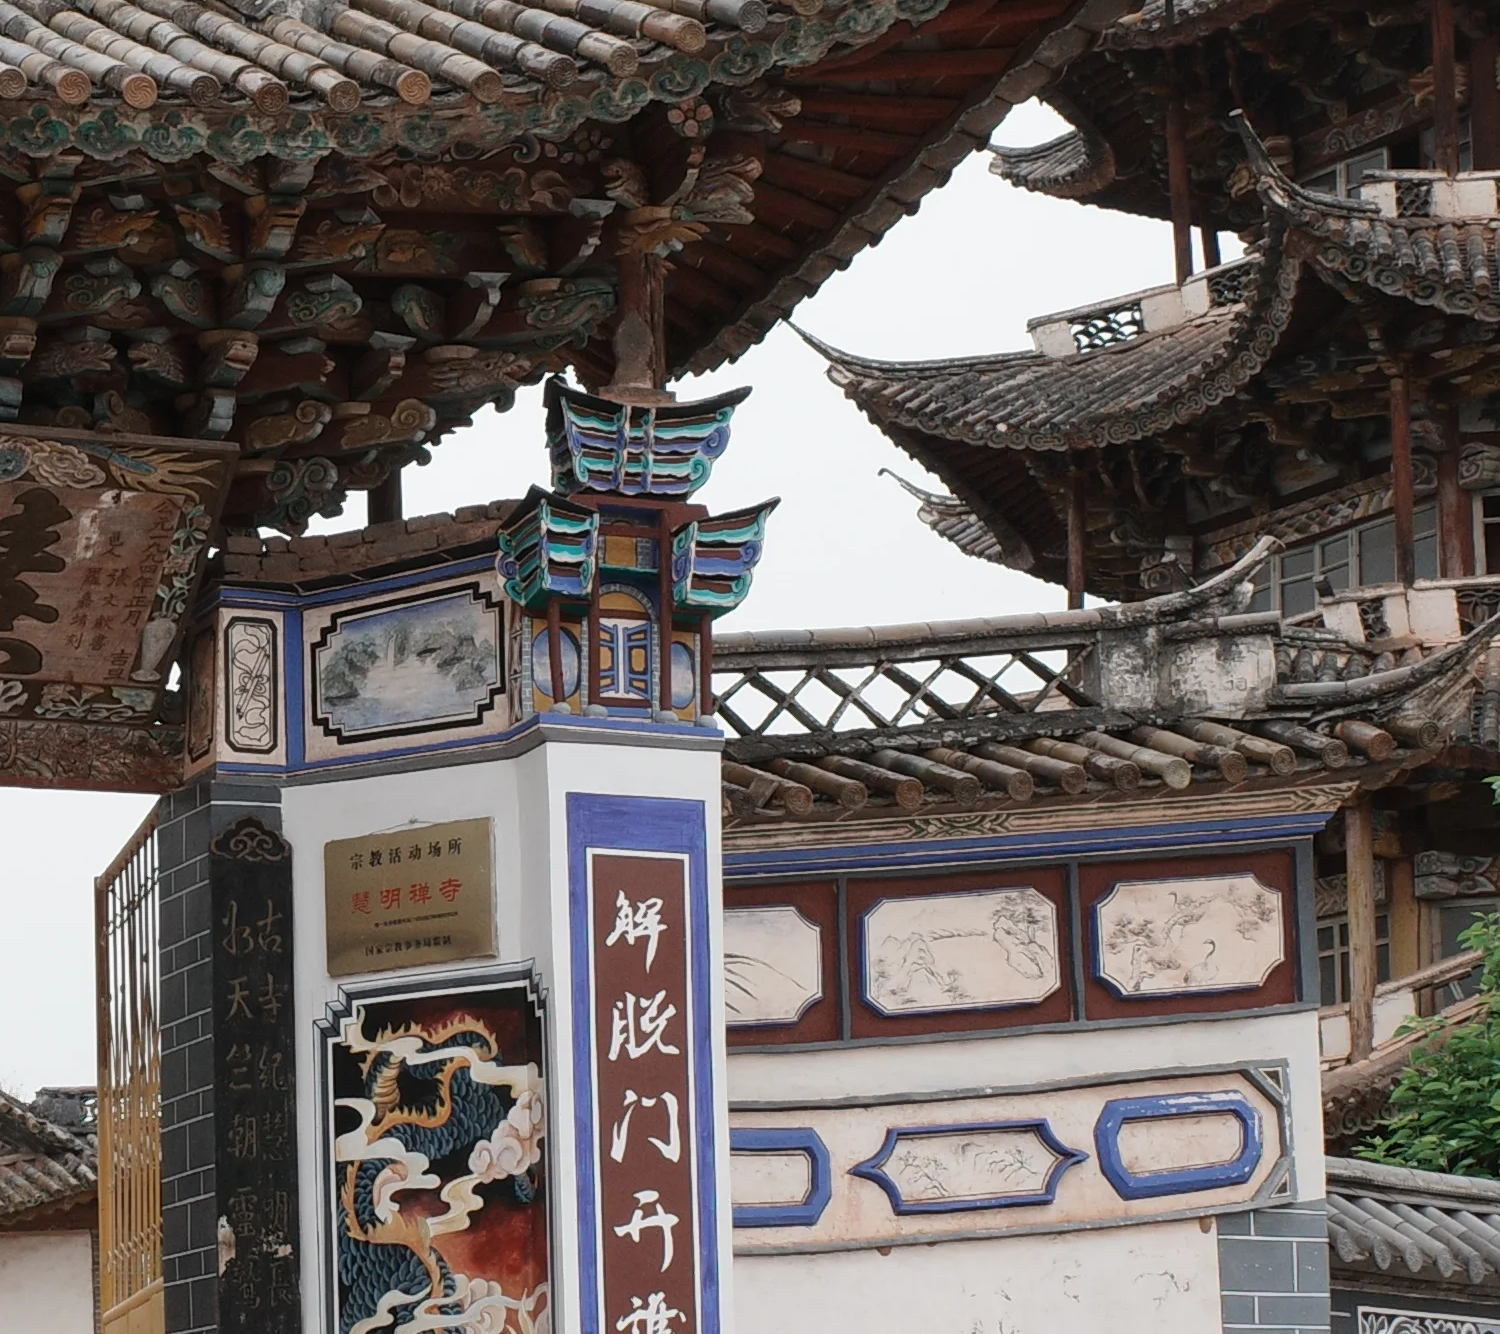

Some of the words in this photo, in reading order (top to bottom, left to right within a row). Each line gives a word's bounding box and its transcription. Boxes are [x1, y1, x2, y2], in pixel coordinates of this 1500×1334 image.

[348, 836, 464, 871] 宗教活动场所
